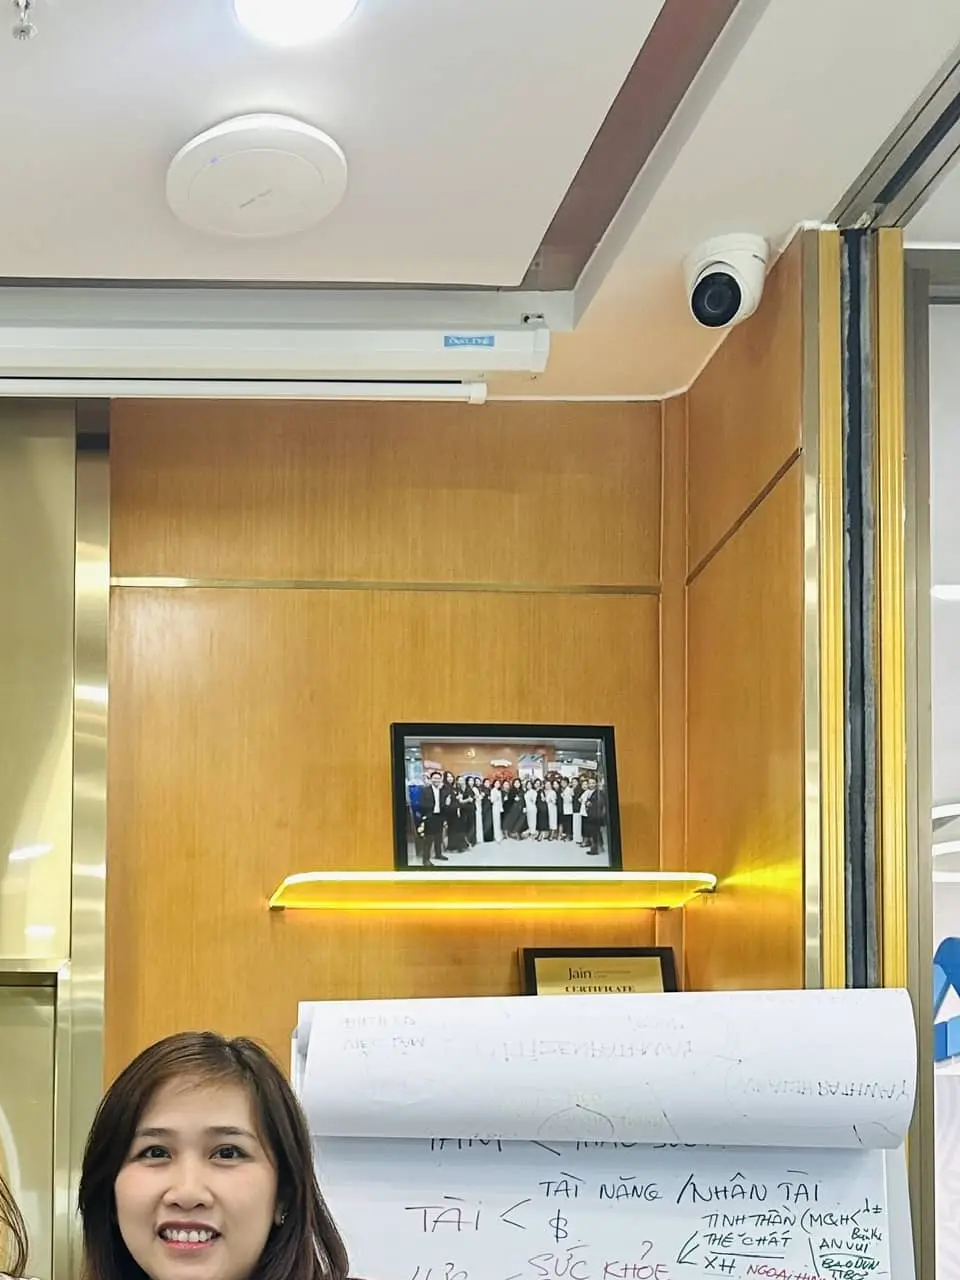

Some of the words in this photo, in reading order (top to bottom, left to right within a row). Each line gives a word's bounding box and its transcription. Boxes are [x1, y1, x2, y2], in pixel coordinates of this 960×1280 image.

[568, 968, 592, 981] Jain
[565, 985, 635, 993] CERTIFICATE
[599, 1176, 663, 1201] NĂNG
